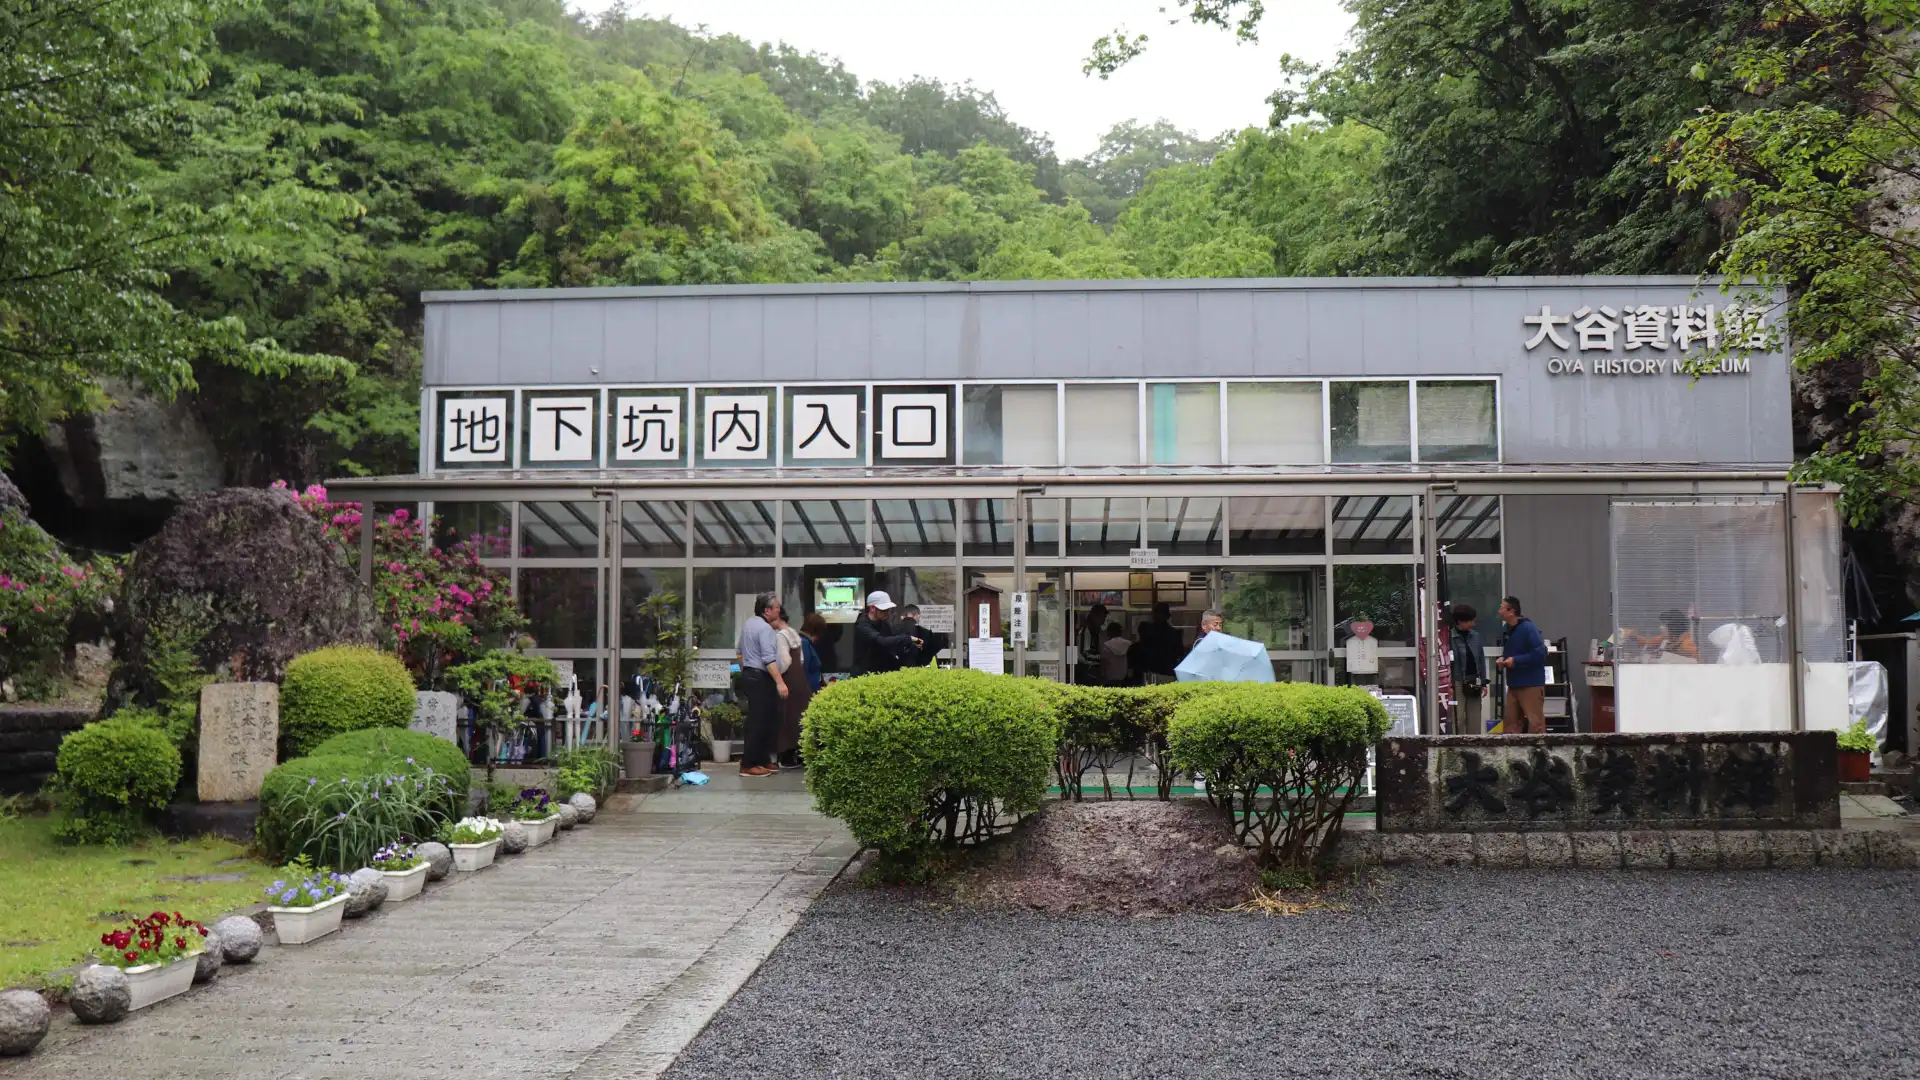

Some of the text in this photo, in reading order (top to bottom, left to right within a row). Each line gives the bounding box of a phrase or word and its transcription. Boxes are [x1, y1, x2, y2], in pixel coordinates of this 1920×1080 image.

[1524, 304, 1767, 350] 大谷資料館
[1594, 358, 1667, 374] HISTORY
[449, 402, 937, 453] 地下坑内入口
[1013, 594, 1023, 639] 段差注意
[1444, 745, 1778, 816] 大谷資料館
